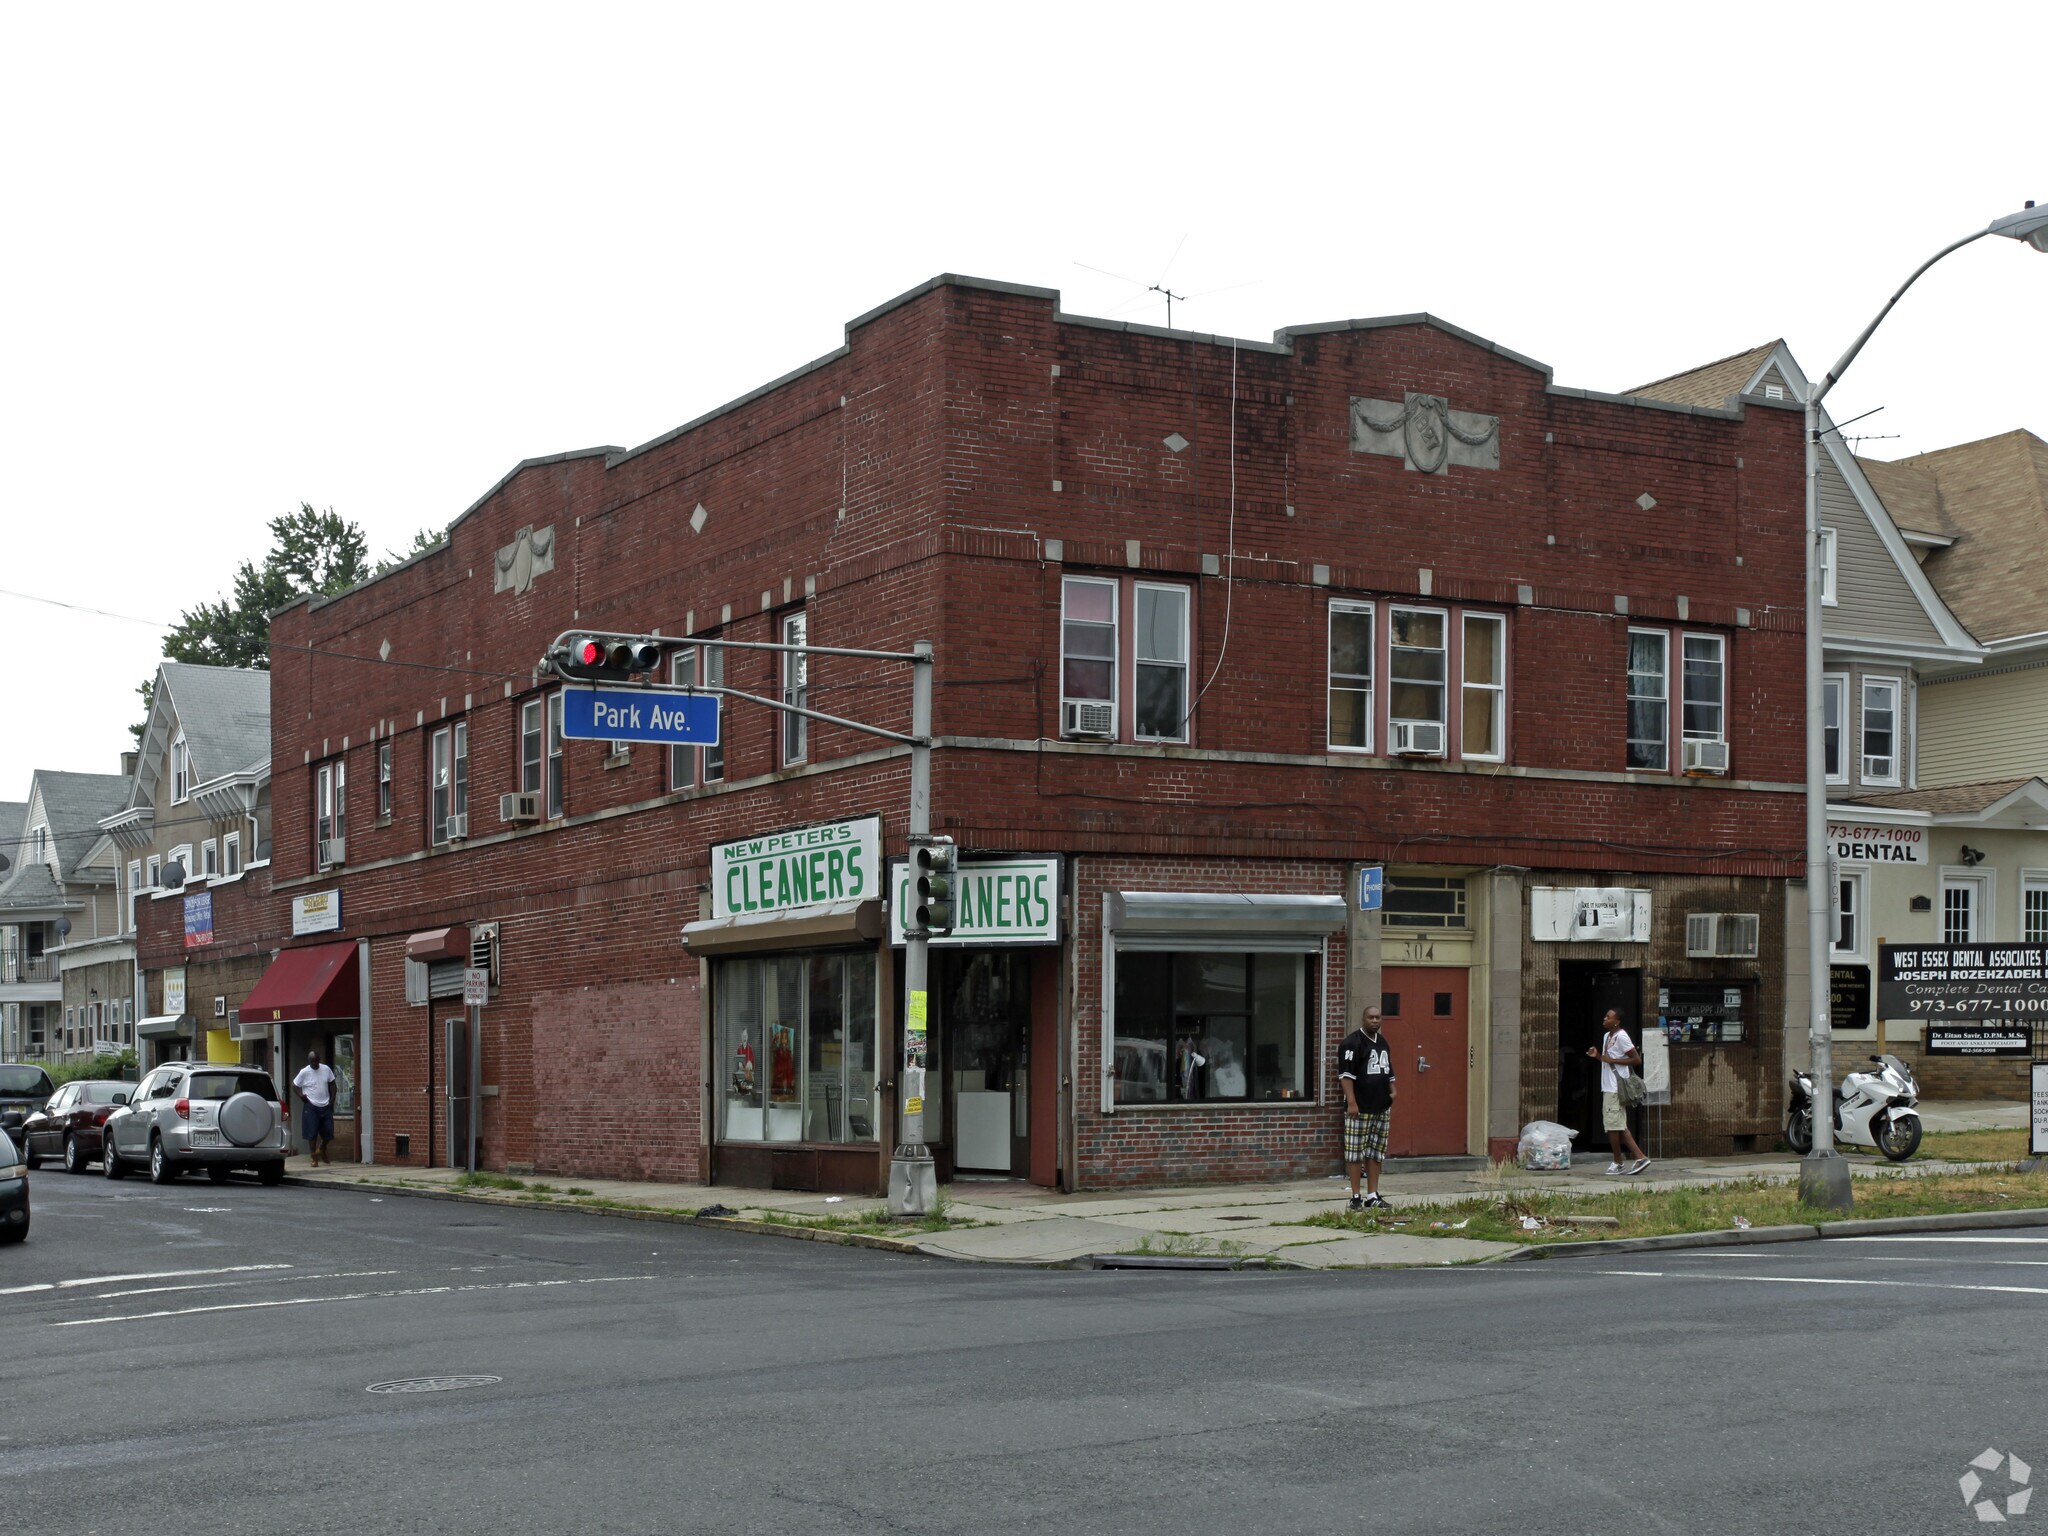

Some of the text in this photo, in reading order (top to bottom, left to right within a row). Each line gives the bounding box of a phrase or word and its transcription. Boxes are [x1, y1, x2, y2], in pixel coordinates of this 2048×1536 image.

[593, 701, 691, 731] Park Ave.
[724, 825, 851, 859] NEW PETER'S
[1827, 825, 1921, 843] 73-677-1000
[1837, 842, 1917, 862] DENTAL
[727, 846, 864, 913] CLEANERS
[1366, 883, 1382, 891] PHONE
[1831, 861, 1839, 908] STOP
[1402, 942, 1434, 961] 304
[1893, 951, 1918, 968] WEST
[1921, 950, 1949, 968] ESSEX
[1952, 950, 1985, 967] DENTAL
[465, 980, 486, 988] PARKING
[472, 972, 481, 980] NO
[1830, 970, 1855, 980] ENTAL
[1894, 970, 1947, 981] JOSEPH
[1905, 983, 2048, 997] Complete Dental Ca
[1909, 999, 2048, 1012] 973-677-1000
[1367, 1049, 1390, 1075] 24
